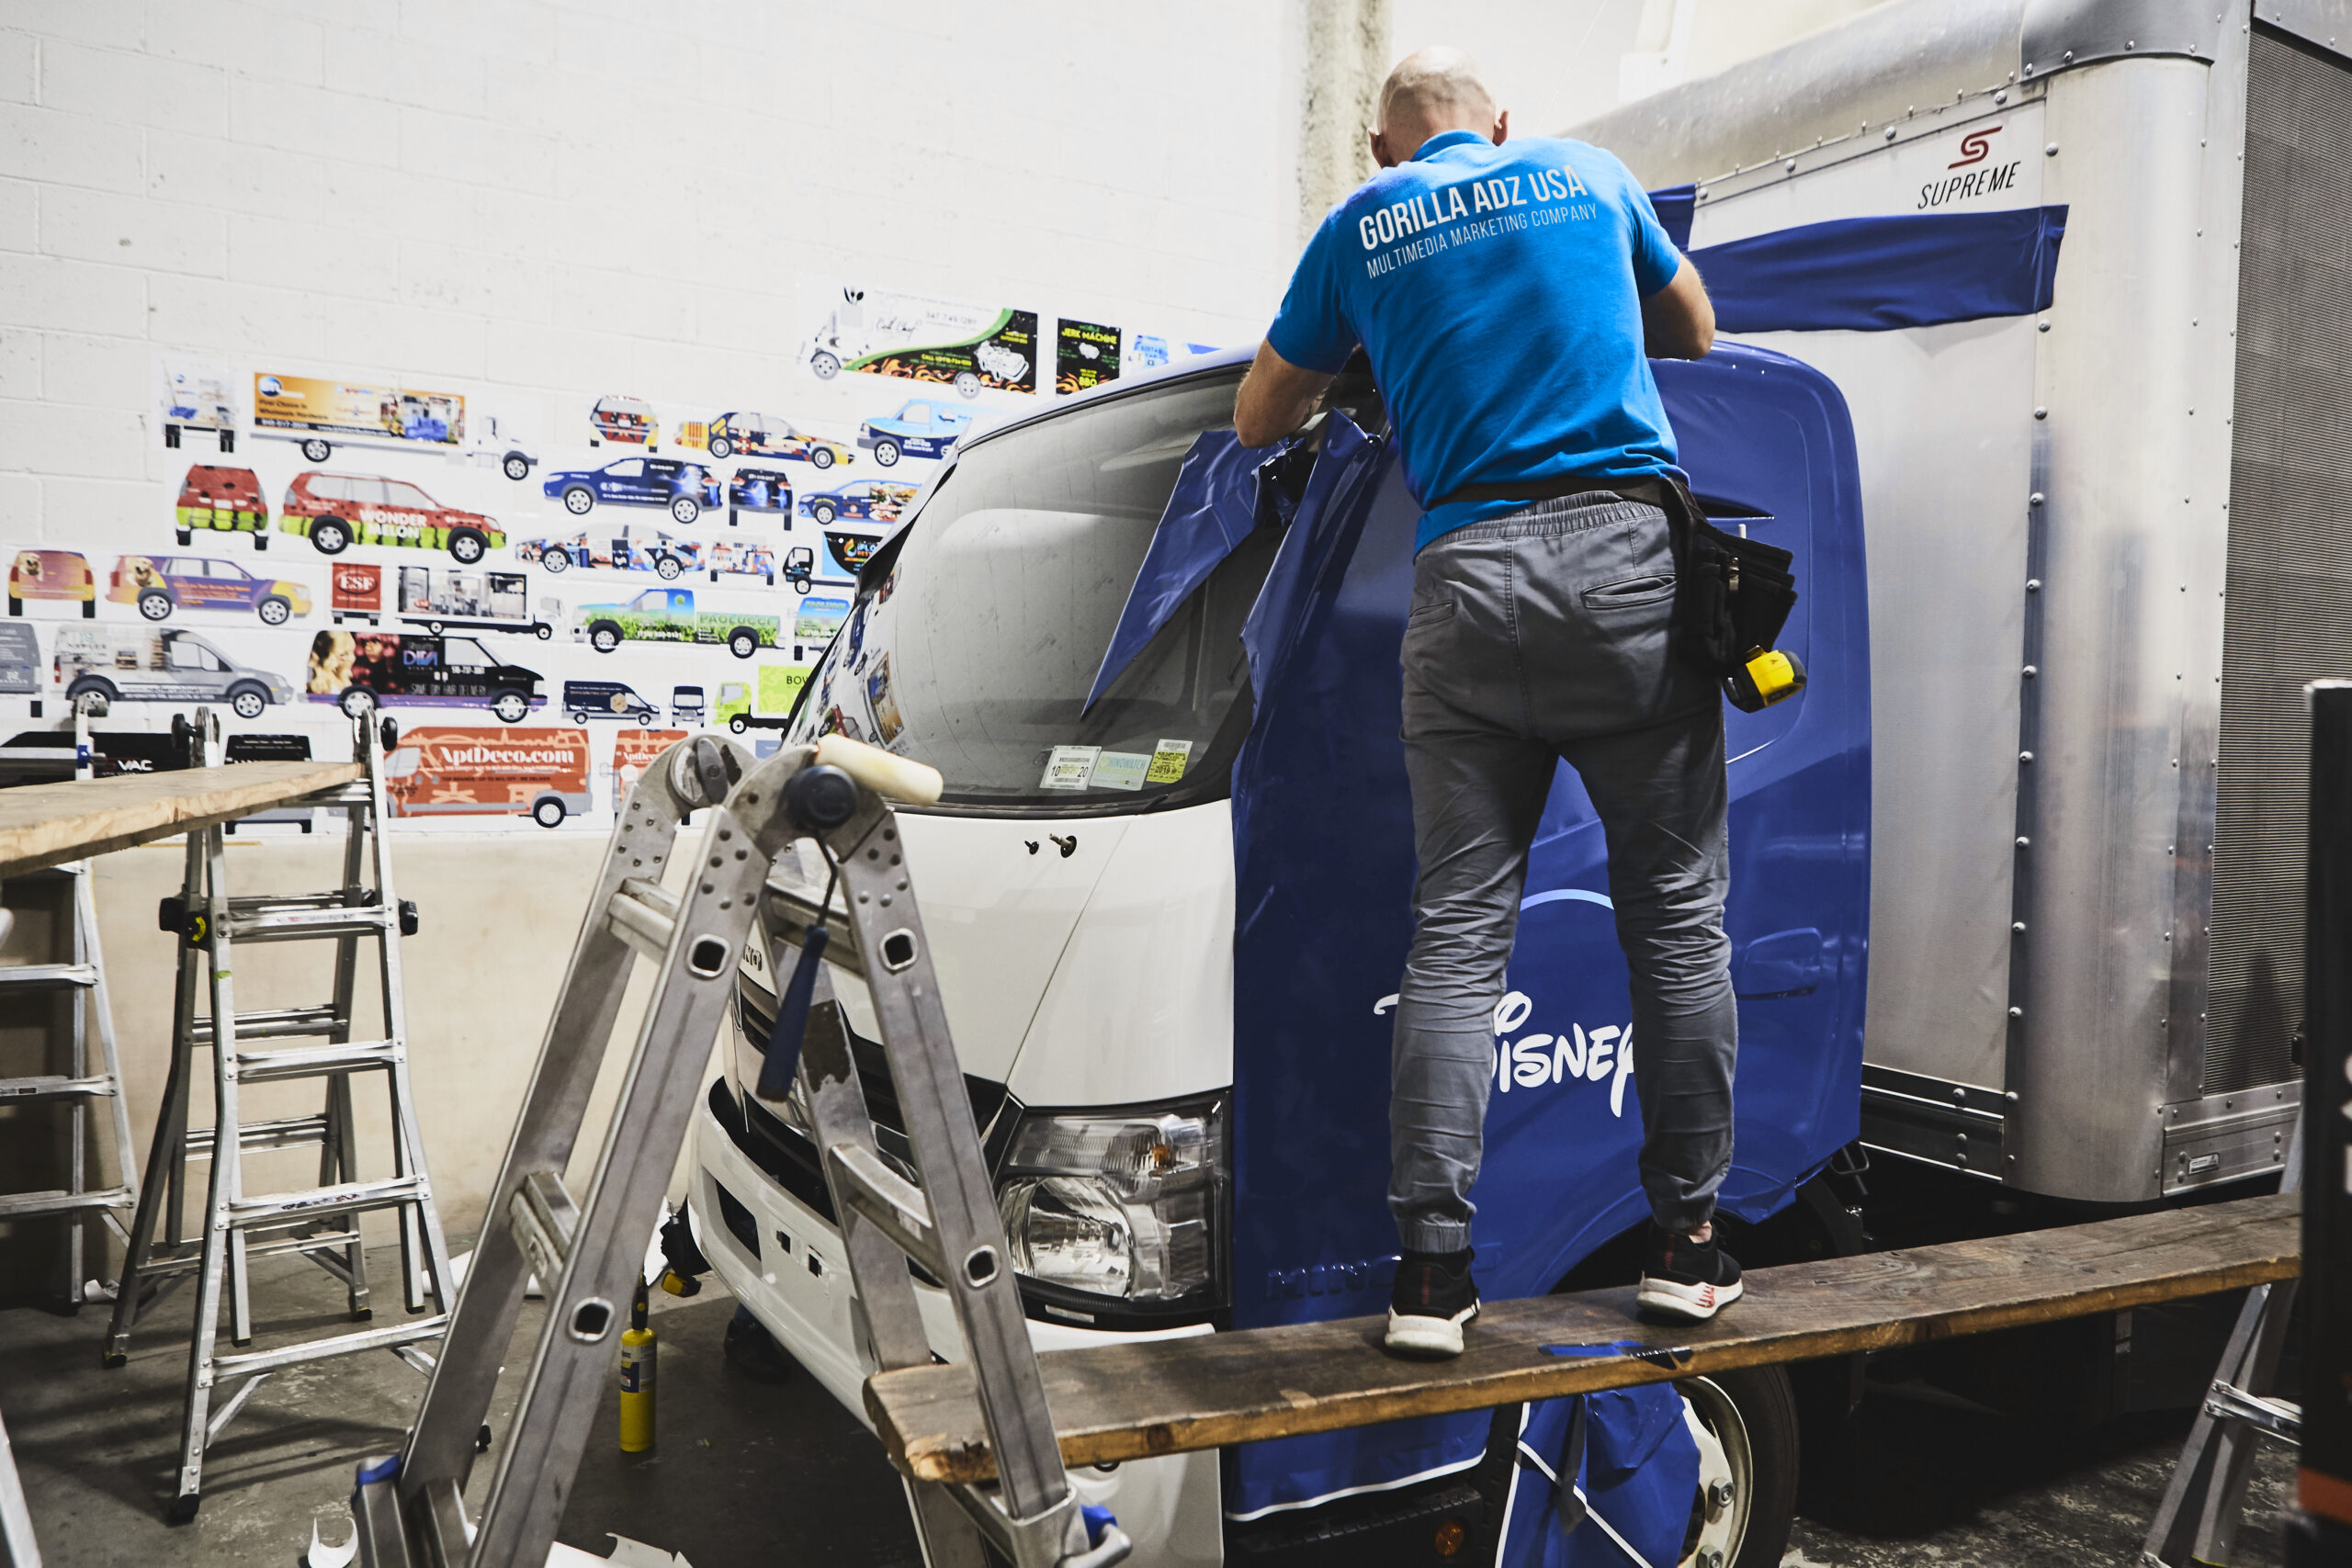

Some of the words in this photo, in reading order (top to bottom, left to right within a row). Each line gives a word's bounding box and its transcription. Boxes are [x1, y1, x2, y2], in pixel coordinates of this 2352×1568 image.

[1917, 161, 2021, 209] SUPREME
[1359, 186, 1469, 251] GORILLA
[1472, 175, 1527, 214] ADZ
[1528, 164, 1589, 202] USA
[1366, 232, 1449, 279] MULTIMEDIA
[1450, 213, 1528, 248] MARKETING
[1531, 202, 1599, 228] COMPANY
[1061, 328, 1081, 339] JERK
[1081, 331, 1117, 345] MACHINE
[359, 509, 427, 527] WONDER
[368, 524, 420, 539] MELON
[699, 614, 771, 626] PAOLUCCI
[1051, 765, 1061, 777] 10
[1077, 766, 1089, 778] 20
